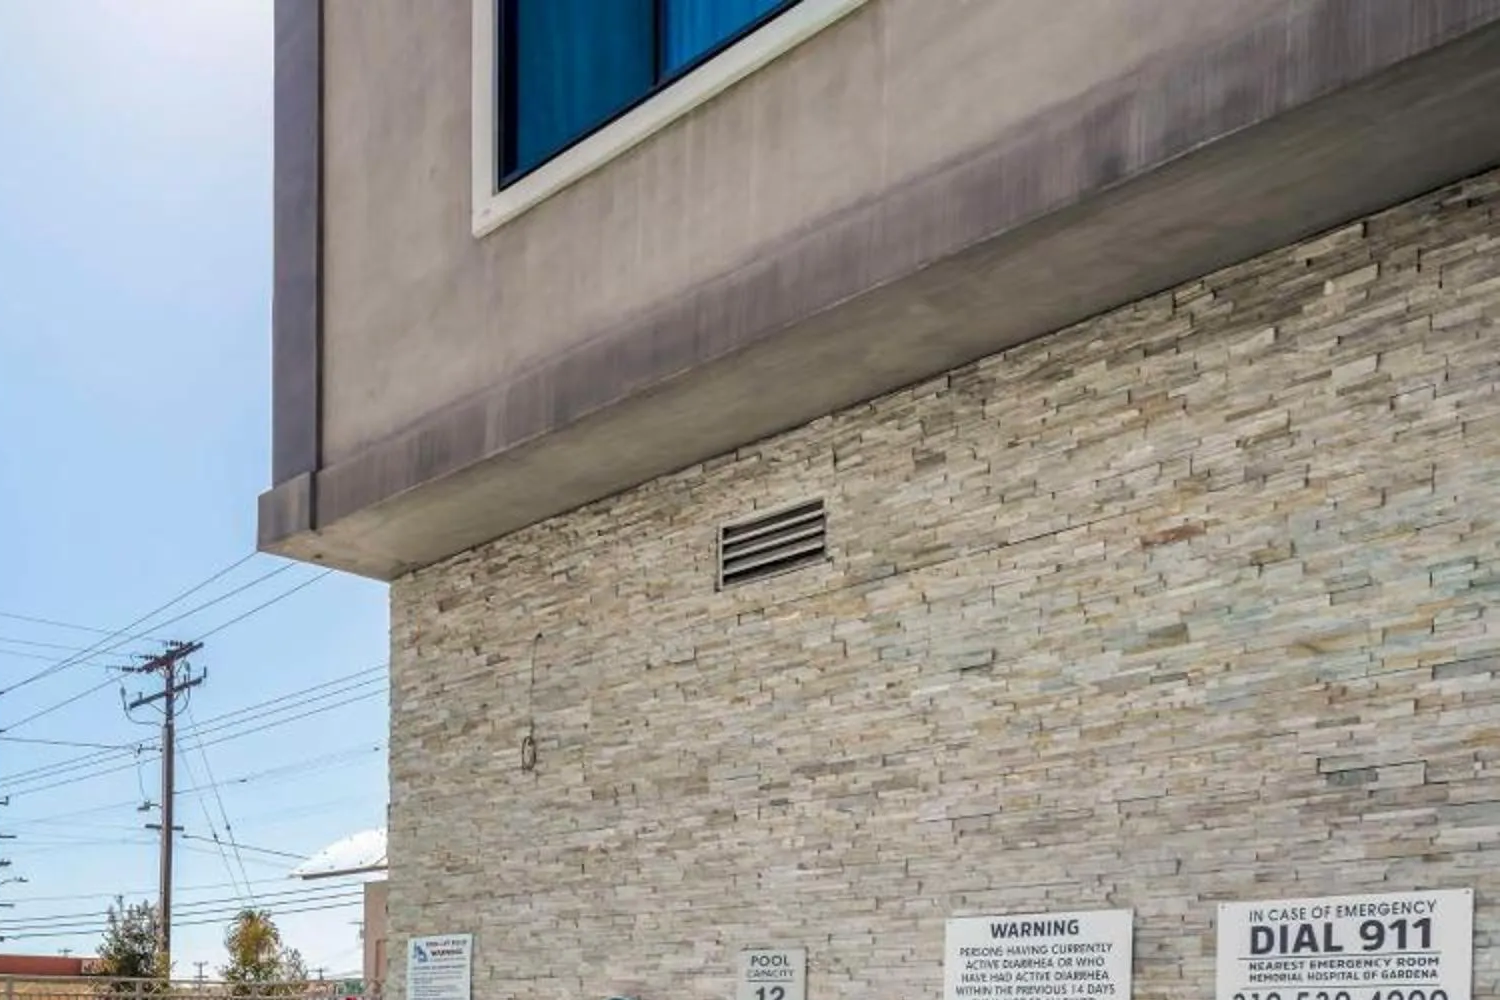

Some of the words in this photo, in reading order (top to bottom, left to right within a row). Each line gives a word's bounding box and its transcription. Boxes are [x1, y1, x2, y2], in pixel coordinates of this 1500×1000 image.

[1249, 910, 1263, 923] IN
[1268, 907, 1307, 921] CASE
[1311, 905, 1331, 919] OF
[1336, 899, 1438, 918] EMERGENCY
[991, 919, 1079, 939] WARNING
[1250, 922, 1344, 955] DIAL
[1359, 917, 1432, 951] 911
[959, 946, 1003, 957] PERSONS
[1007, 945, 1049, 956] HAVING
[1051, 943, 1113, 955] CURRENTLY
[751, 954, 790, 968] POOL
[965, 959, 1000, 971] ACTIVE
[1058, 957, 1073, 967] OR
[1076, 956, 1106, 967] WHO
[1249, 960, 1304, 972] NEAREST
[1309, 957, 1392, 971] EMERGENCY
[1397, 956, 1440, 968] ROOM
[746, 968, 796, 979] CAPACITY
[1015, 971, 1050, 982] ACTIVE
[1249, 972, 1302, 983] MEMORIAL
[1307, 970, 1360, 982] HOSPITAL
[1363, 971, 1378, 980] OF
[1381, 968, 1438, 980] GARDENA
[956, 985, 992, 996] WITHIN
[996, 985, 1013, 995] THE
[1015, 984, 1067, 995] PREVIOUS
[1071, 983, 1084, 994] 14
[1087, 983, 1116, 995] DAYS
